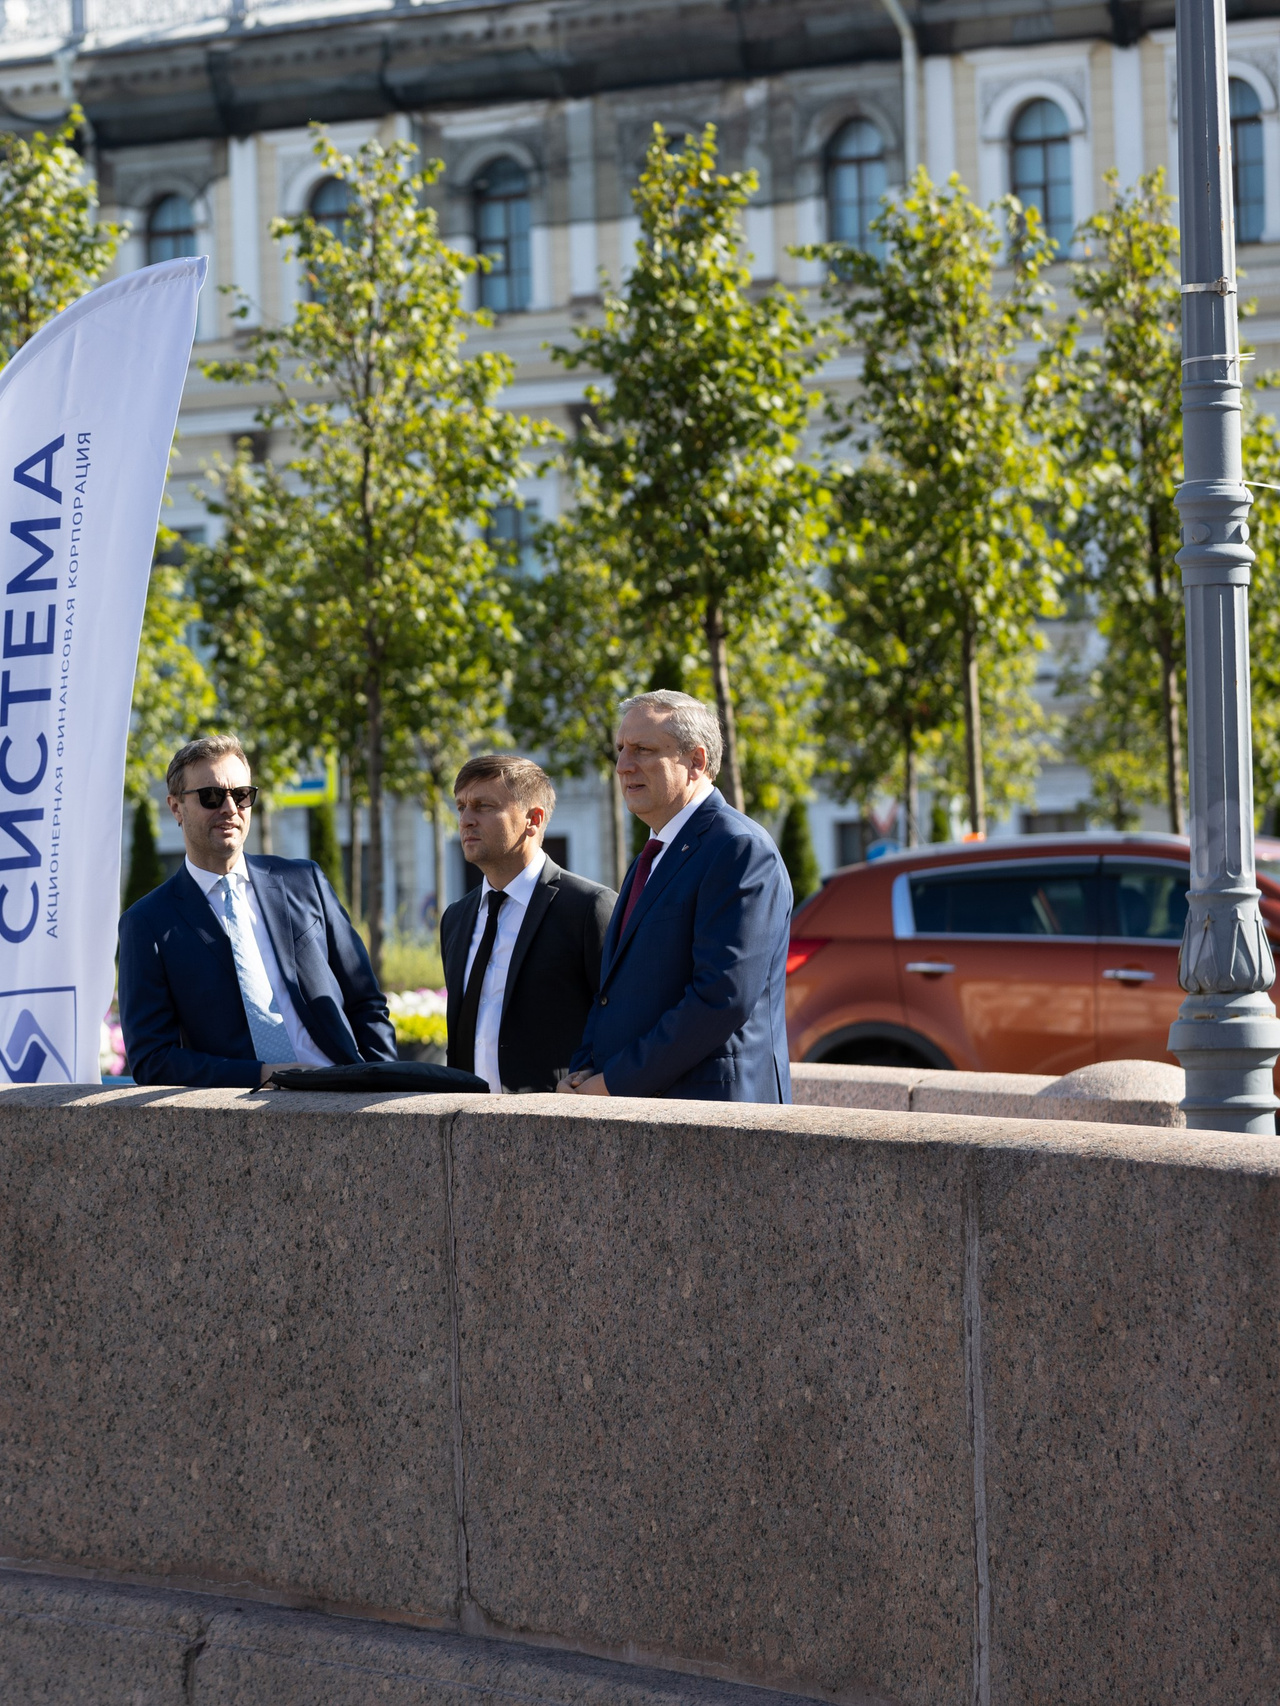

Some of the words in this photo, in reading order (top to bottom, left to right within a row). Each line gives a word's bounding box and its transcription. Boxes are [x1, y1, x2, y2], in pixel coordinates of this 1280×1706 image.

[46, 766, 64, 939] АКЦИОНЕРНАЯ
[56, 598, 76, 758] ФИНАНСОВАЯ
[67, 432, 92, 589] КОРПОРАЦИЯ
